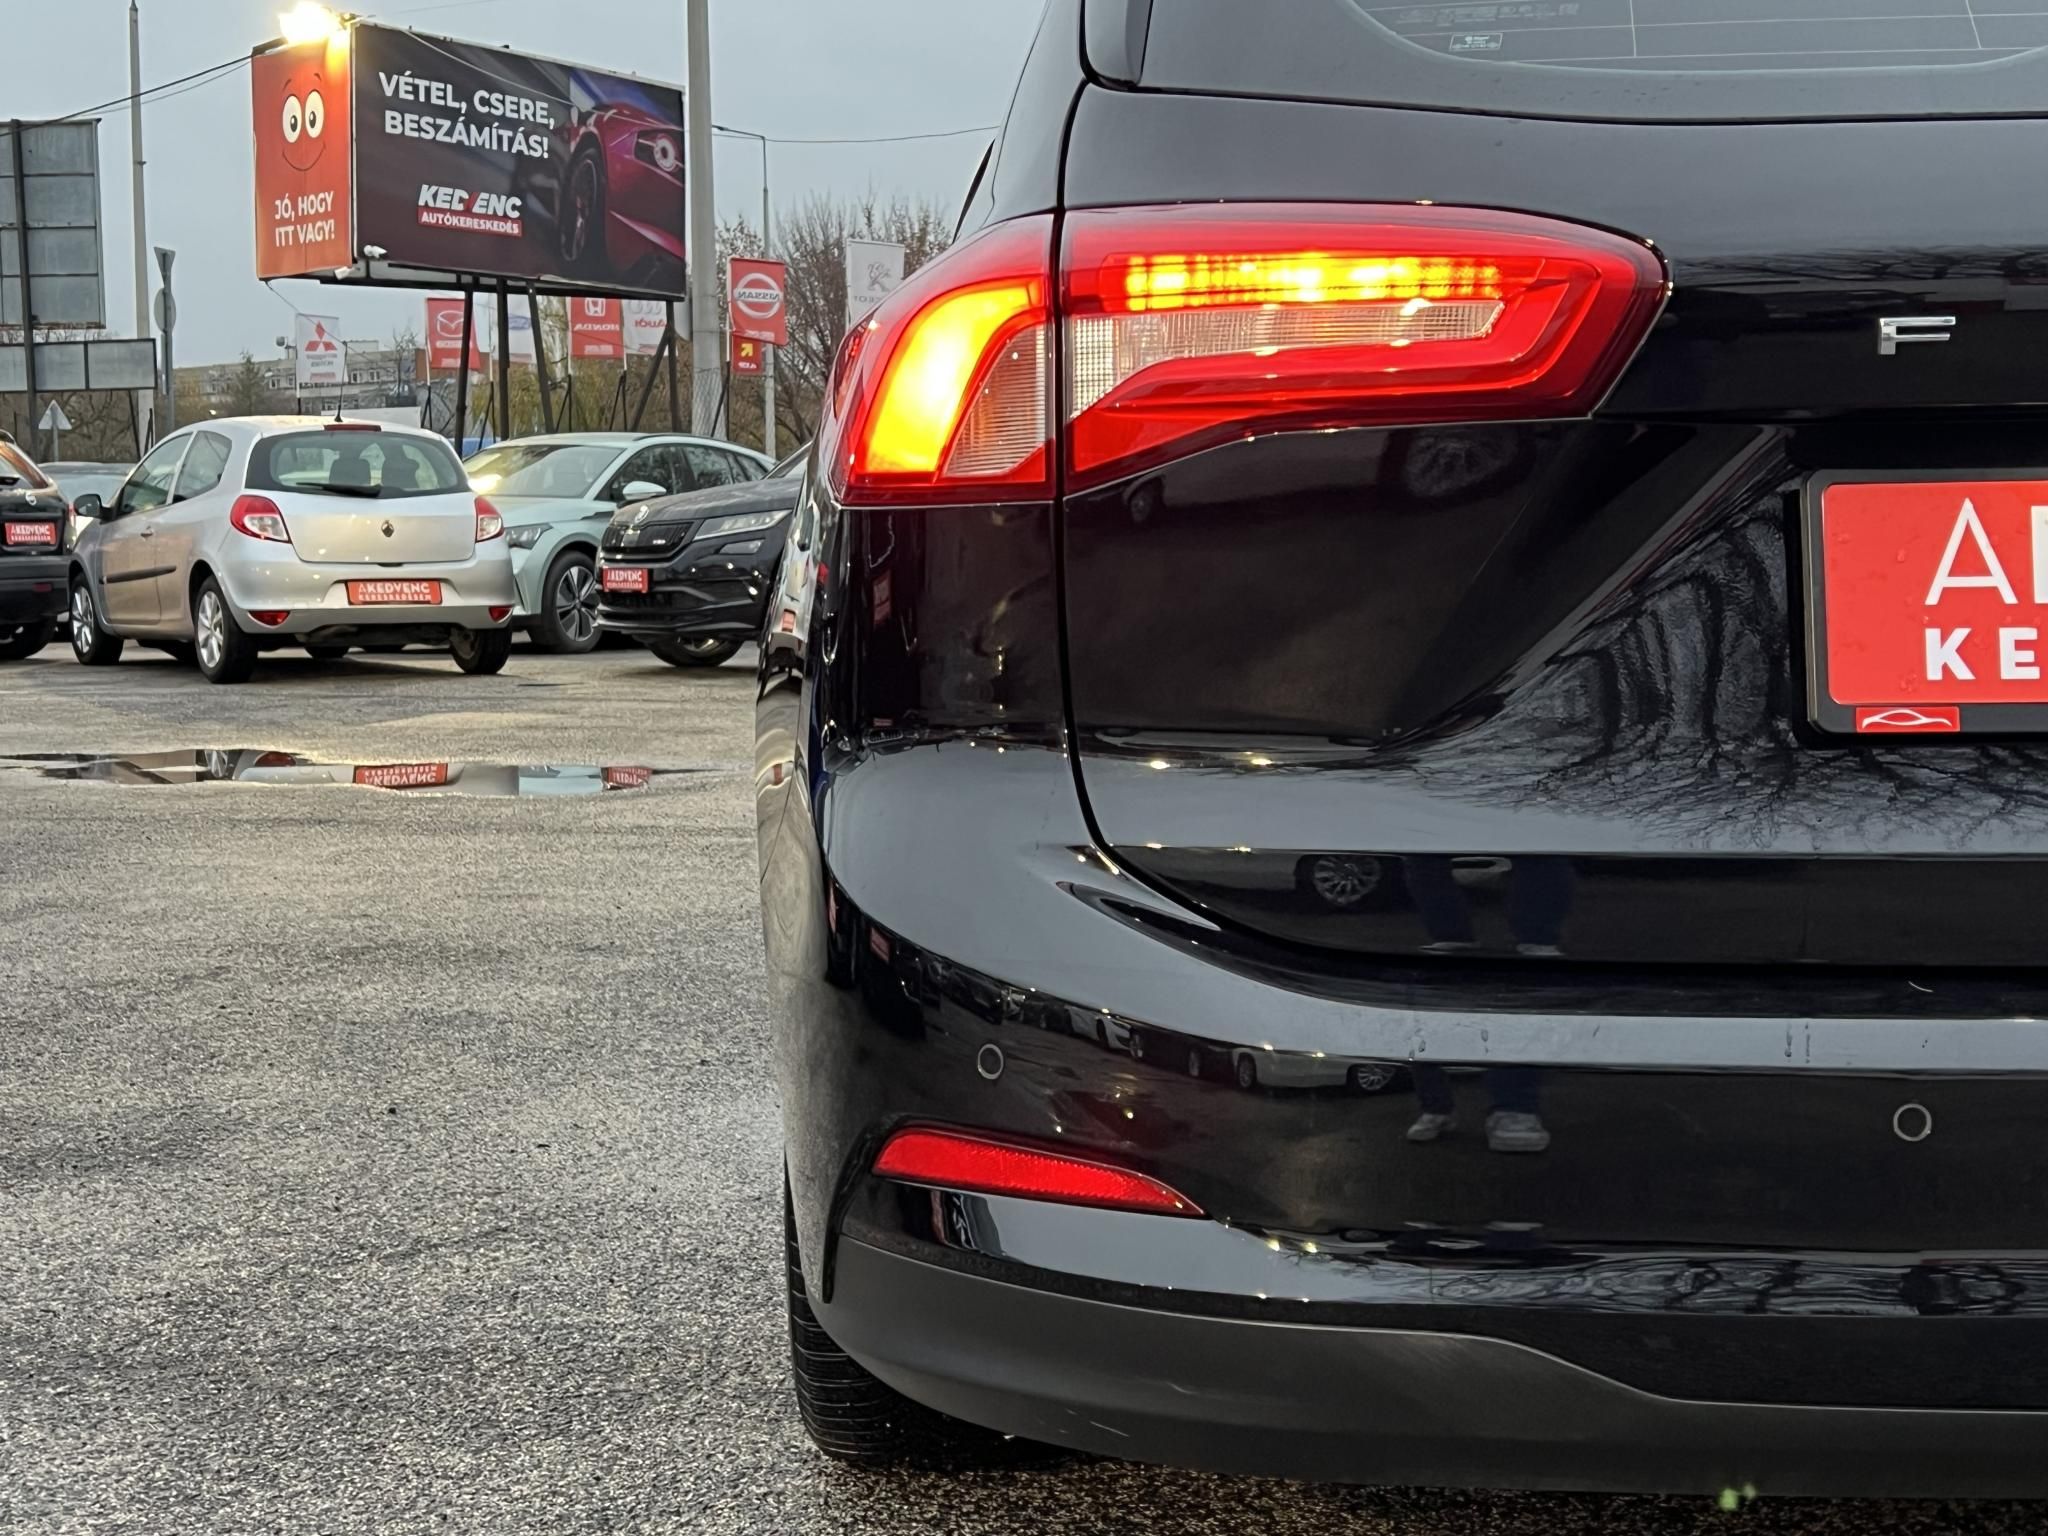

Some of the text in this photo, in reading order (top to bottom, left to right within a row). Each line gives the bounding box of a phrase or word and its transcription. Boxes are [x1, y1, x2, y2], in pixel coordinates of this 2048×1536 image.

[379, 70, 555, 130] VÉTEL, CSERE,
[385, 110, 550, 159] BESZÁMÍTÁS!
[274, 190, 335, 222] JÓ, HOGY
[421, 212, 519, 234] AUTÓKERESKEDÉS
[275, 219, 335, 247] ITT VAGY!
[1878, 316, 1956, 355] F
